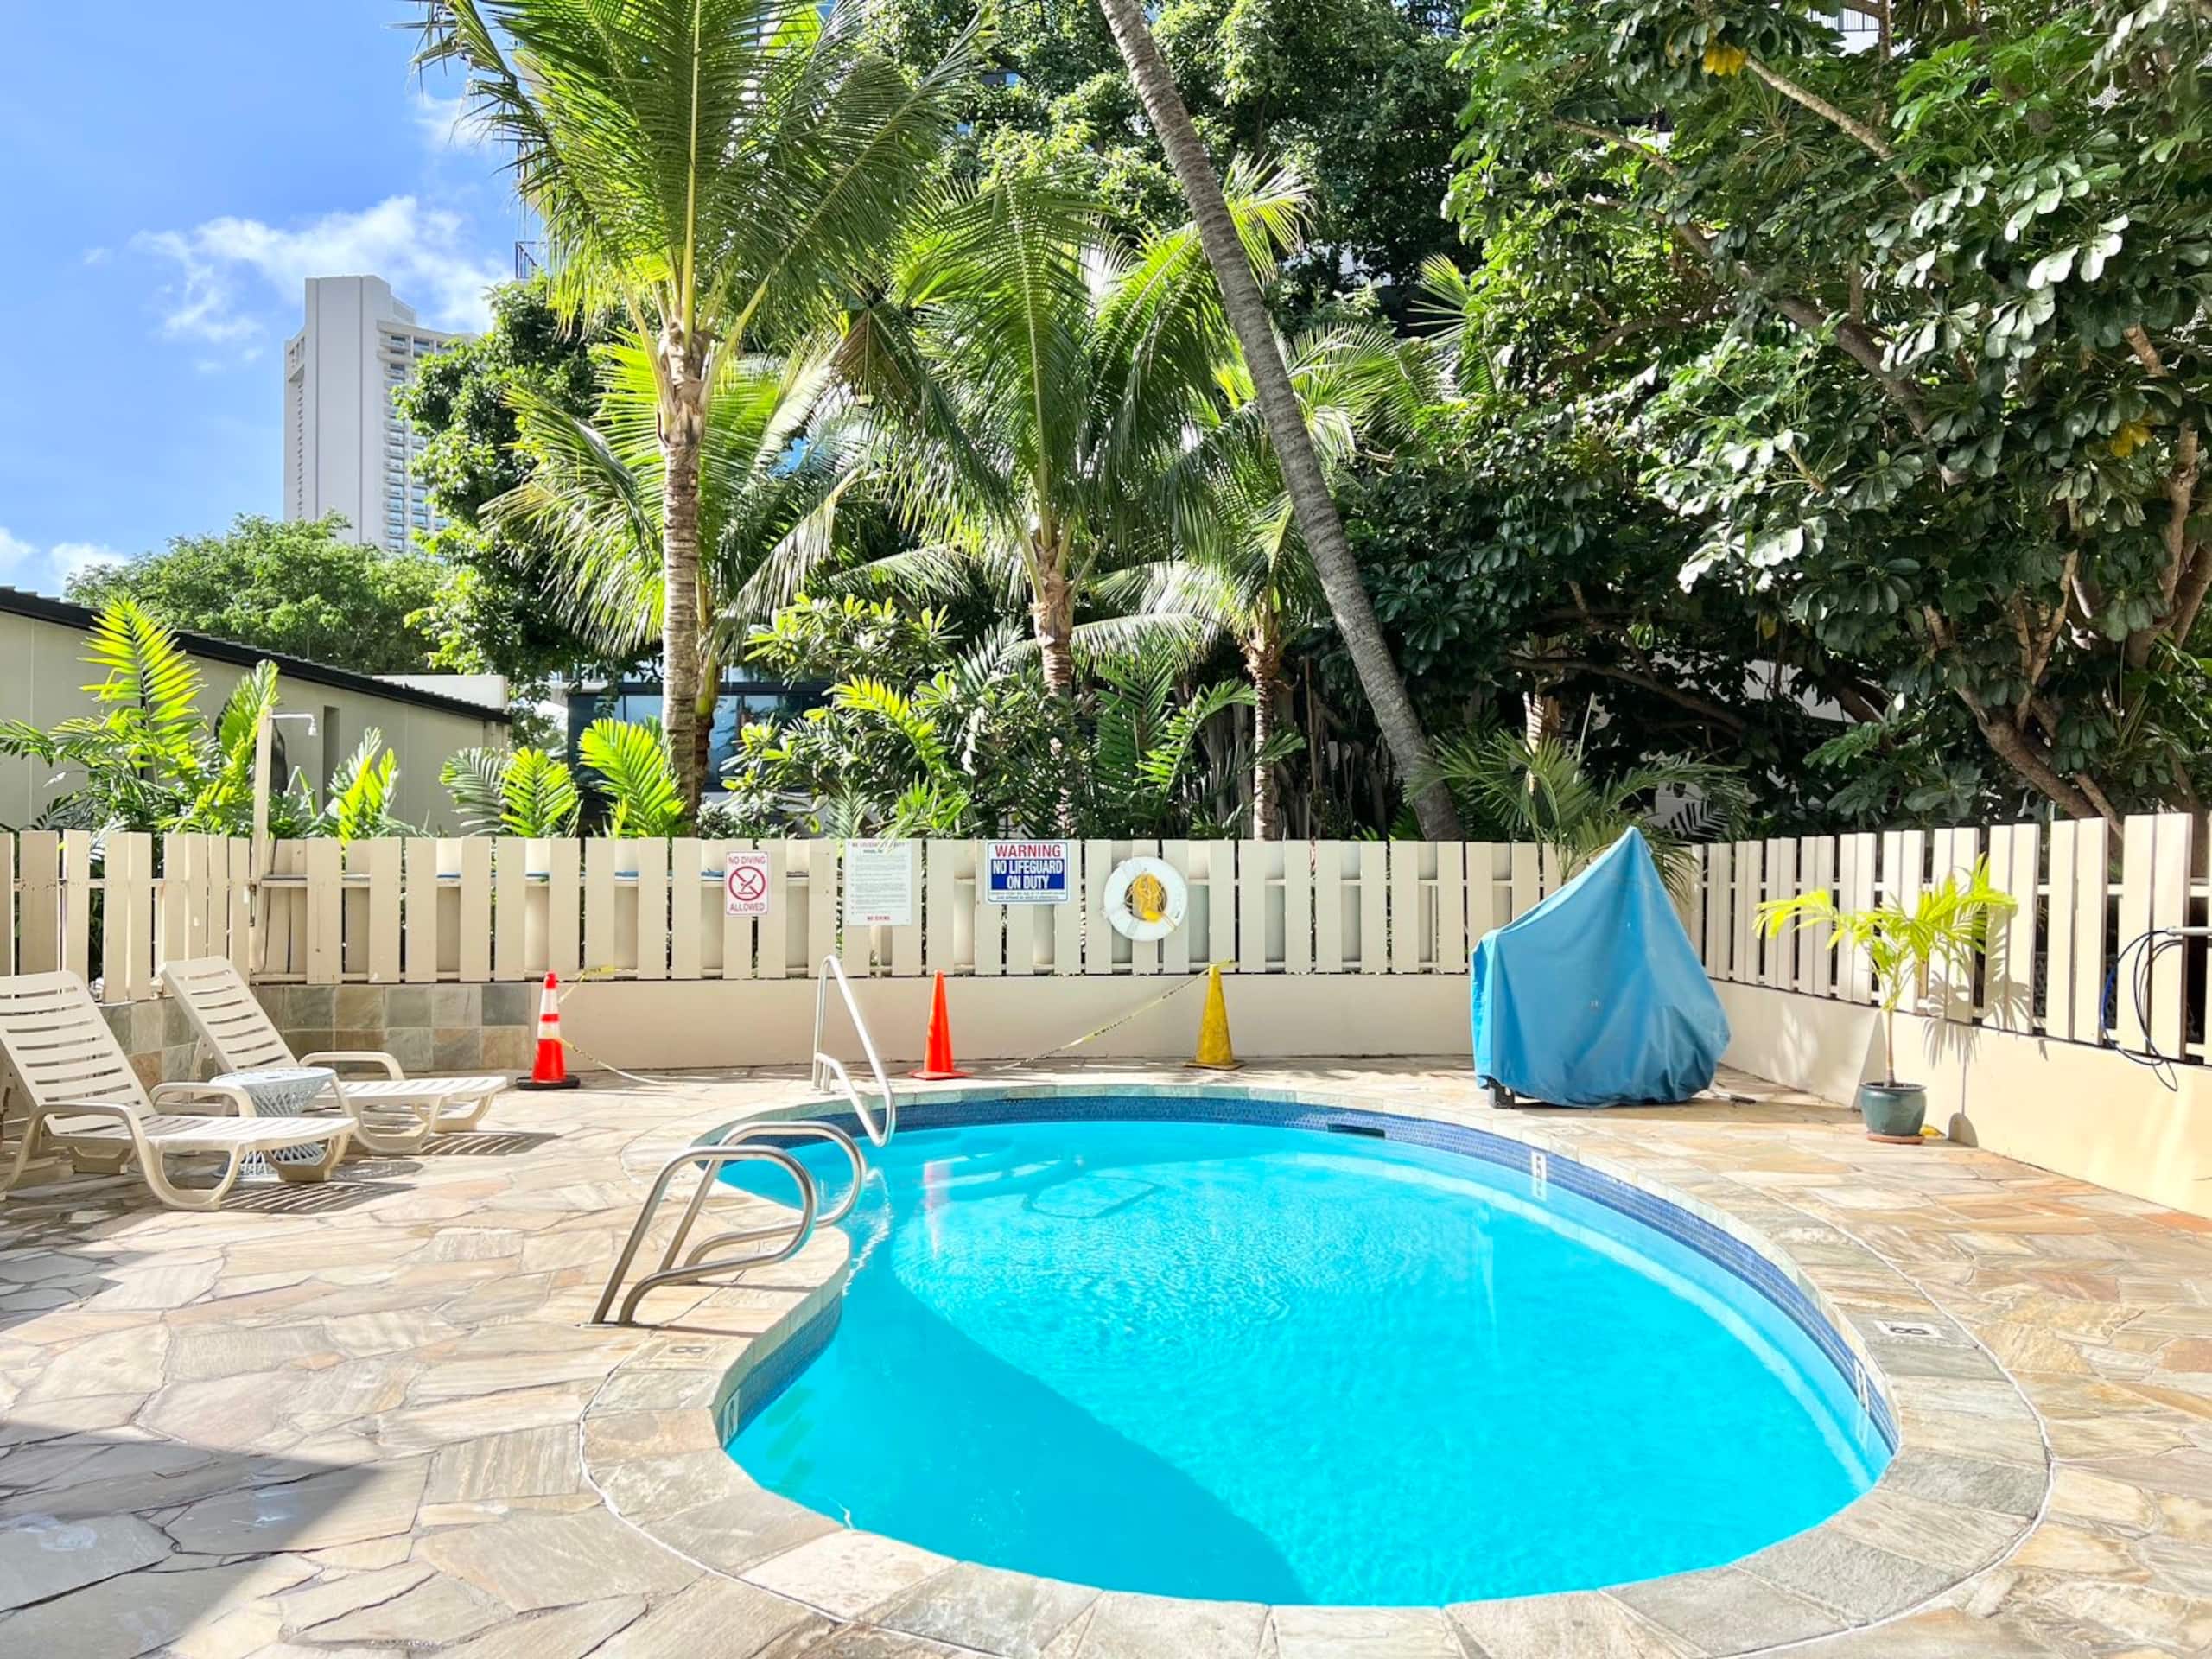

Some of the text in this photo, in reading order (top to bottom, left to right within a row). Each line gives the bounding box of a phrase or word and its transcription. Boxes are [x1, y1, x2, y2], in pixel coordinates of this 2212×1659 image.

[995, 844, 1061, 857] WARNING
[993, 860, 1063, 874] NO LIFEGUARD
[1007, 875, 1050, 889] ON DUTY
[730, 903, 765, 912] ALLOWED
